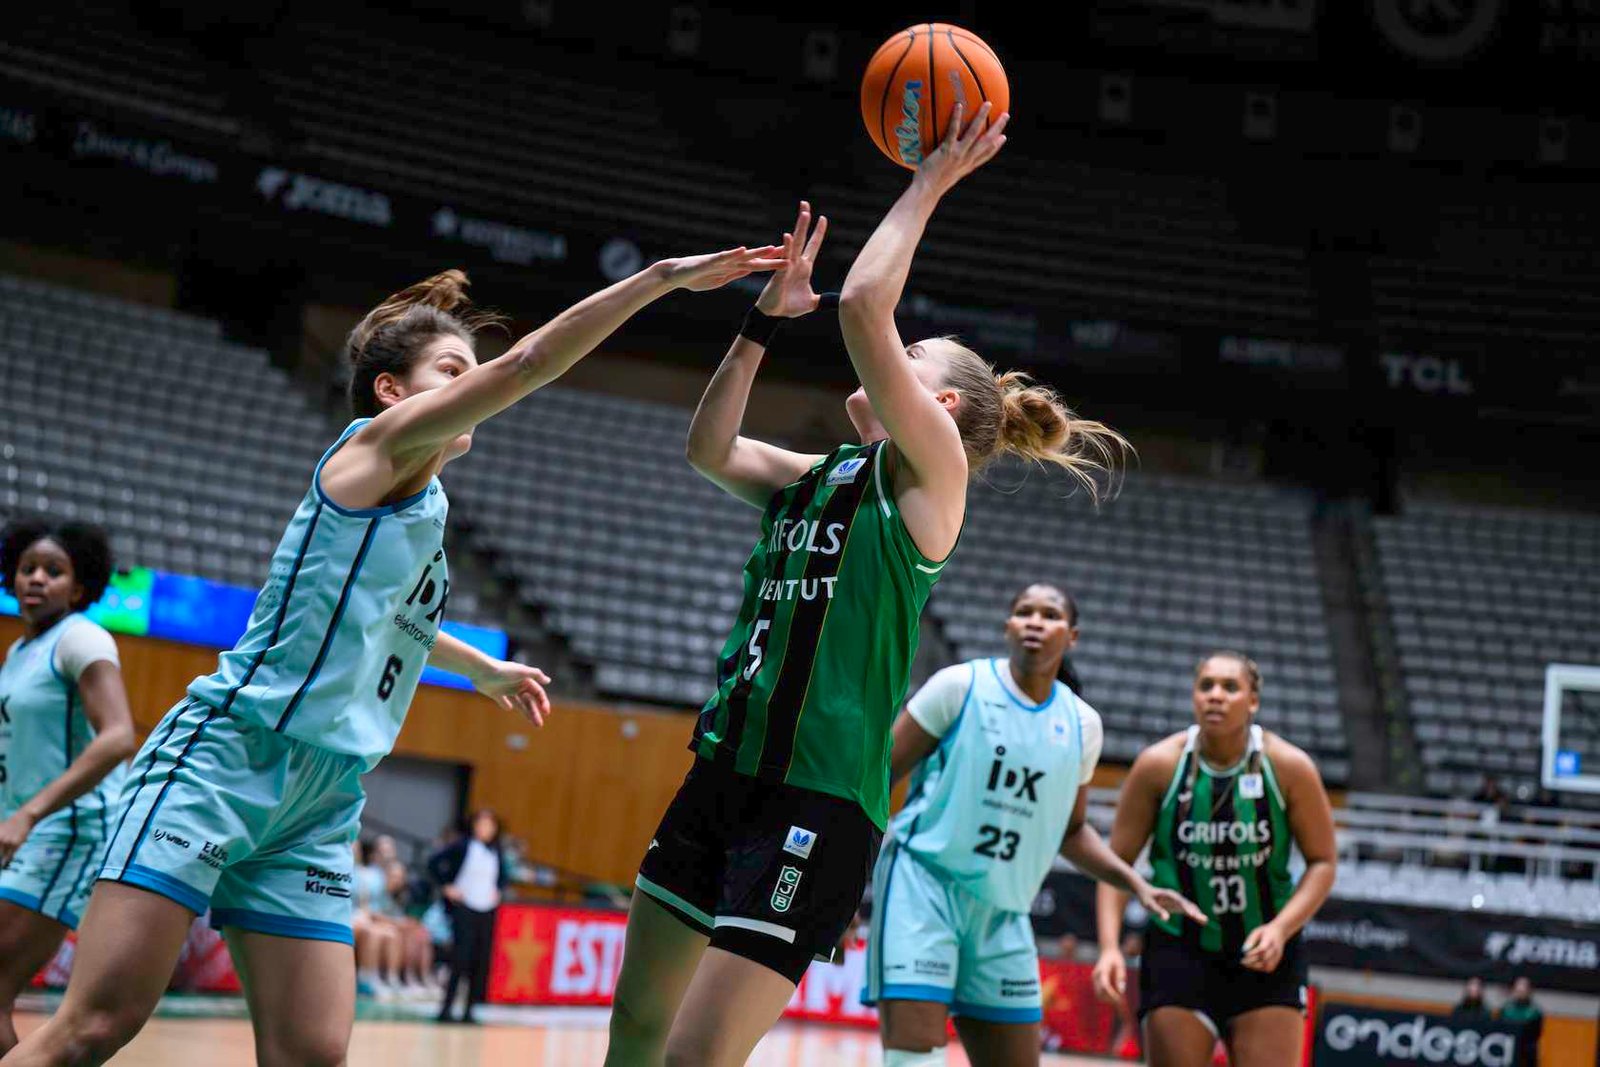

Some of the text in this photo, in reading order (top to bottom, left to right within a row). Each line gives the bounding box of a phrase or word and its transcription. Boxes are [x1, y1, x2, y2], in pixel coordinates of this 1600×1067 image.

[1380, 351, 1475, 397] TCL
[767, 516, 846, 556] RIFOLS
[743, 619, 771, 681] 5
[377, 654, 404, 703] 6
[973, 824, 1021, 862] 23
[1177, 819, 1272, 845] GRIFOLS
[1208, 874, 1248, 915] 33
[550, 918, 628, 998] EST
[1323, 1013, 1517, 1067] endesa
